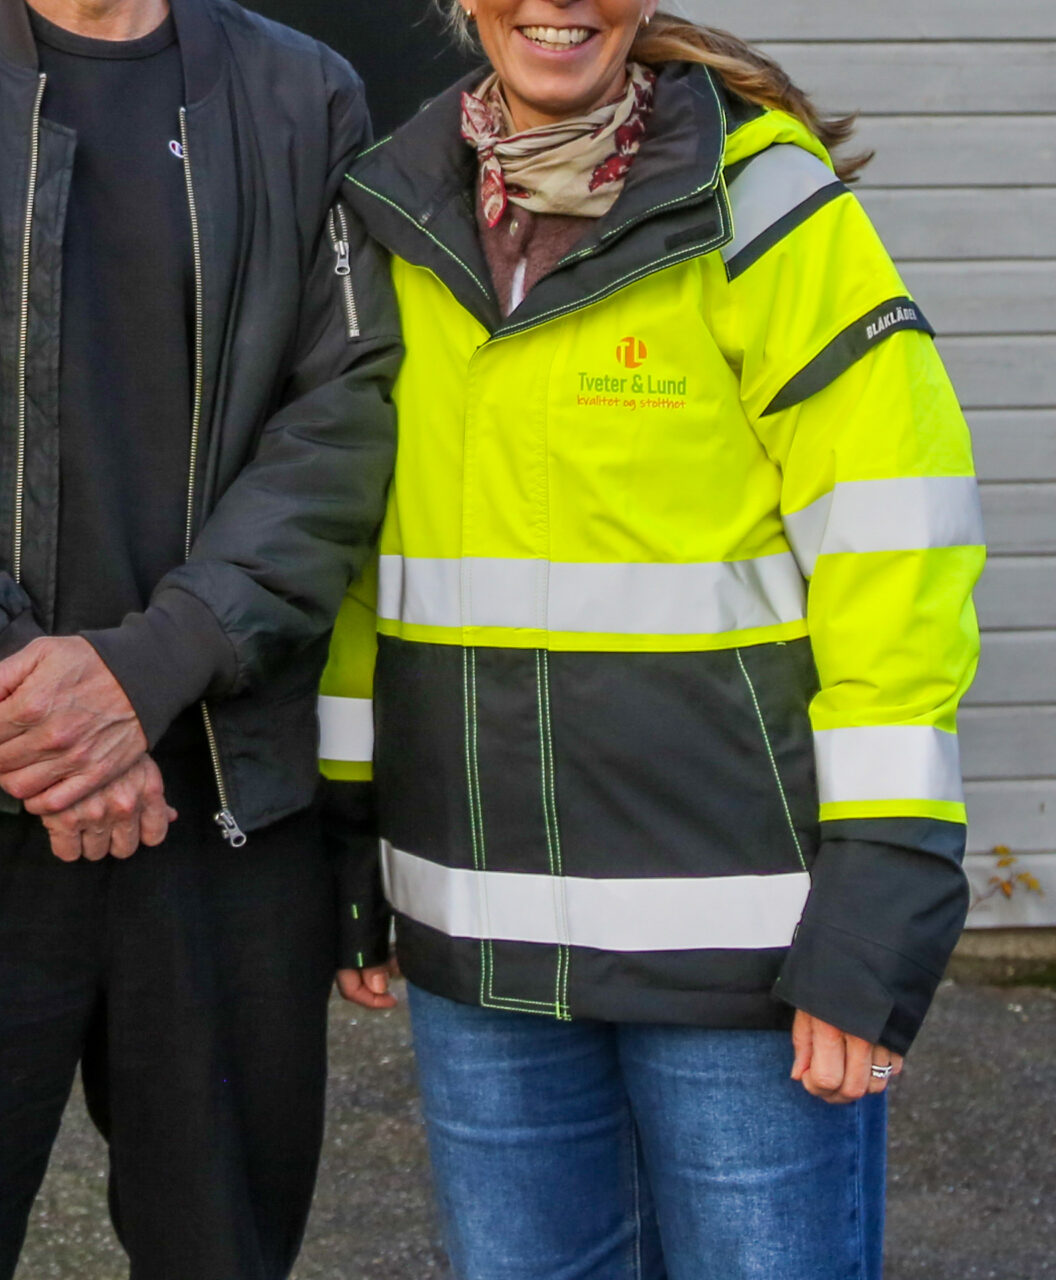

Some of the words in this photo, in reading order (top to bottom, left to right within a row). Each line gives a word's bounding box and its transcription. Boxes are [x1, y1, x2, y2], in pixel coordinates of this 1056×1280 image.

[578, 372, 627, 393] Tveter
[630, 374, 644, 393] &
[647, 374, 687, 395] Lund
[577, 394, 620, 406] kvalitet
[623, 399, 636, 411] og
